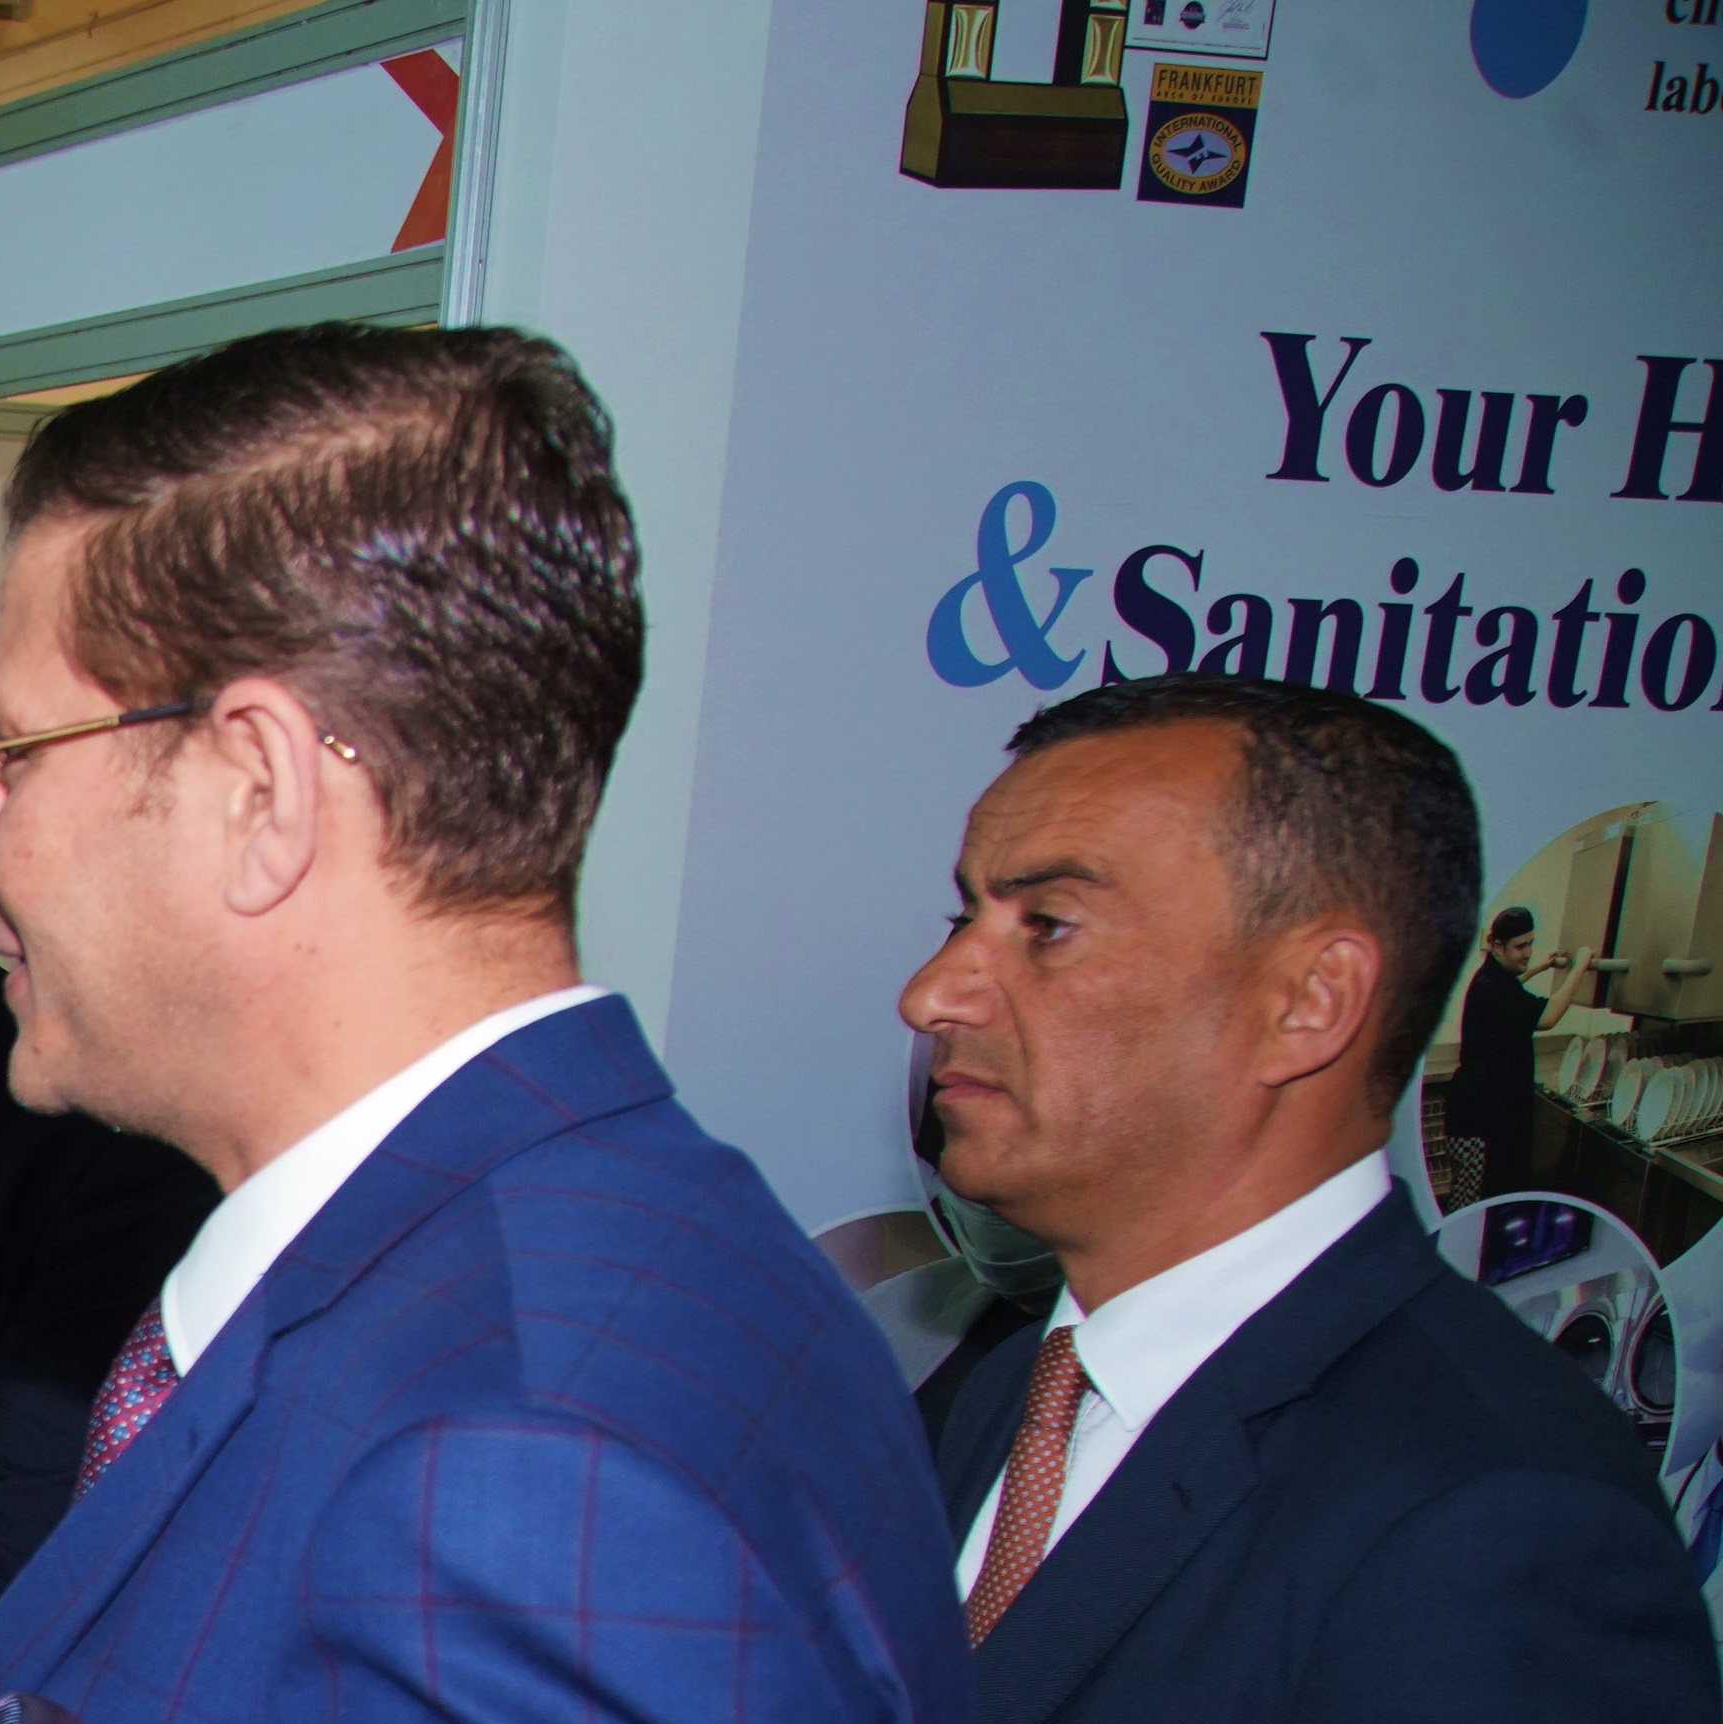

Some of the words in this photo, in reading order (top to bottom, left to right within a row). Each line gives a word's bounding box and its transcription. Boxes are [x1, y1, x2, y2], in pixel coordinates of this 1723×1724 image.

[1157, 69, 1257, 96] FRANKFURT
[1644, 60, 1723, 114] lab
[1153, 115, 1243, 153] INTERNATIONAL
[1152, 153, 1195, 192] QUALITY
[1198, 160, 1241, 192] AWARD
[1259, 331, 1589, 495] Your
[1100, 544, 1723, 712] Sanitatio
